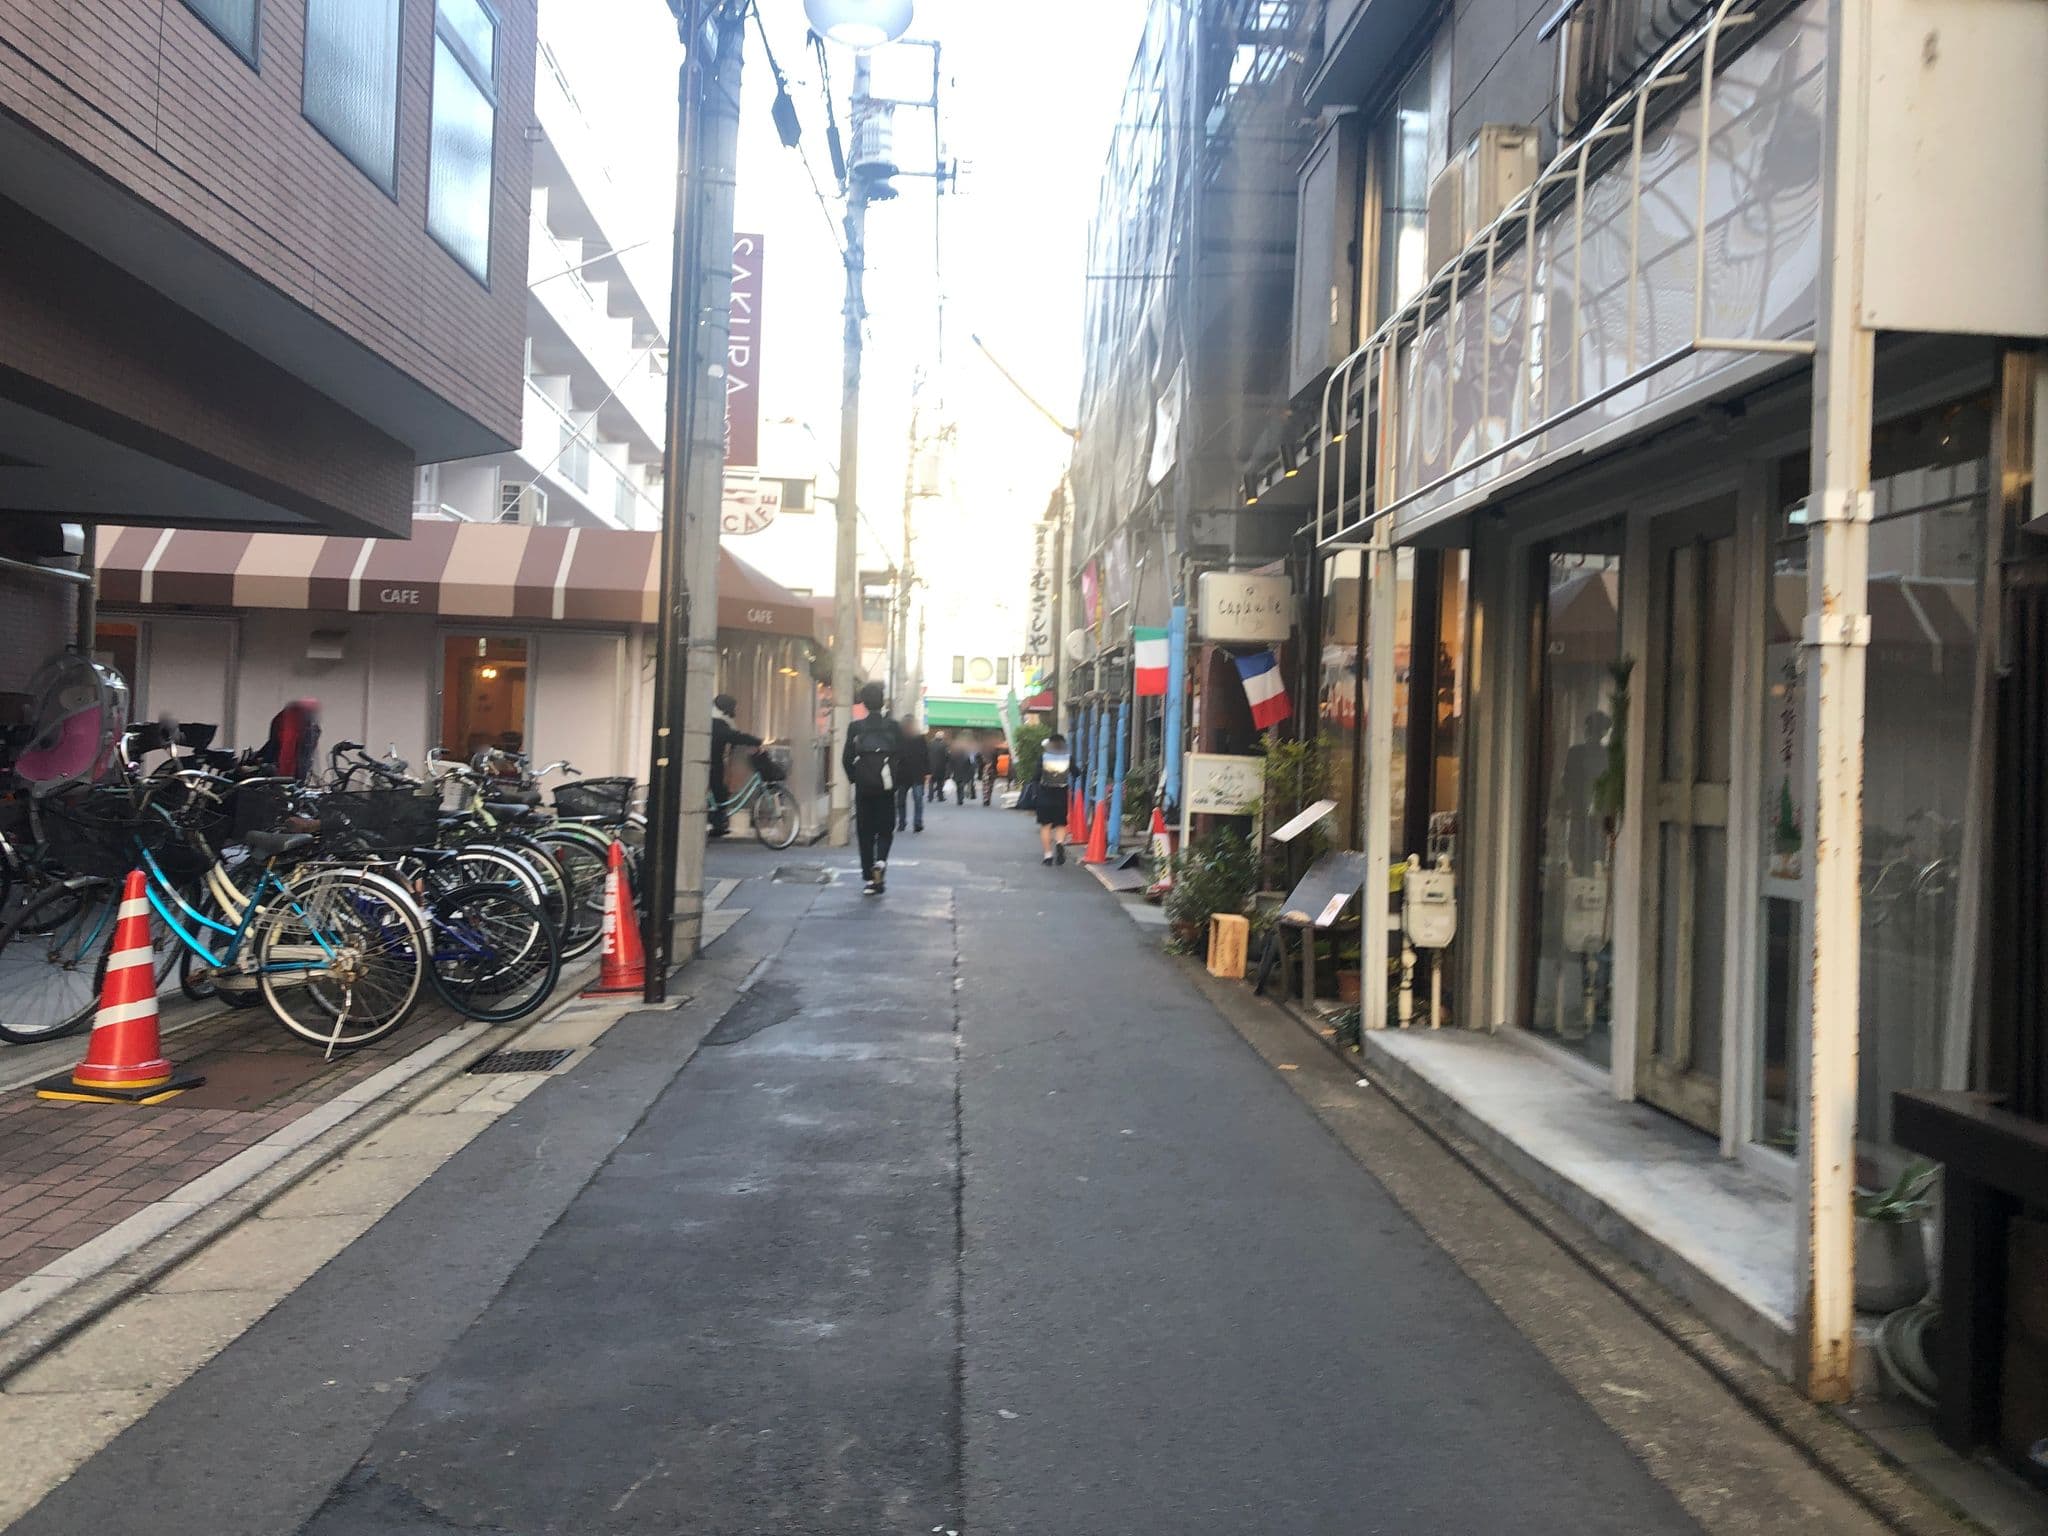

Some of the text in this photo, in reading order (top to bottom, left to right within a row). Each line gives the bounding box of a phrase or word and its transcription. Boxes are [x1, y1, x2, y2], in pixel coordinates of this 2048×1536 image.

[723, 495, 778, 533] CAFE
[380, 588, 420, 604] CAFE
[747, 608, 774, 625] CAFE
